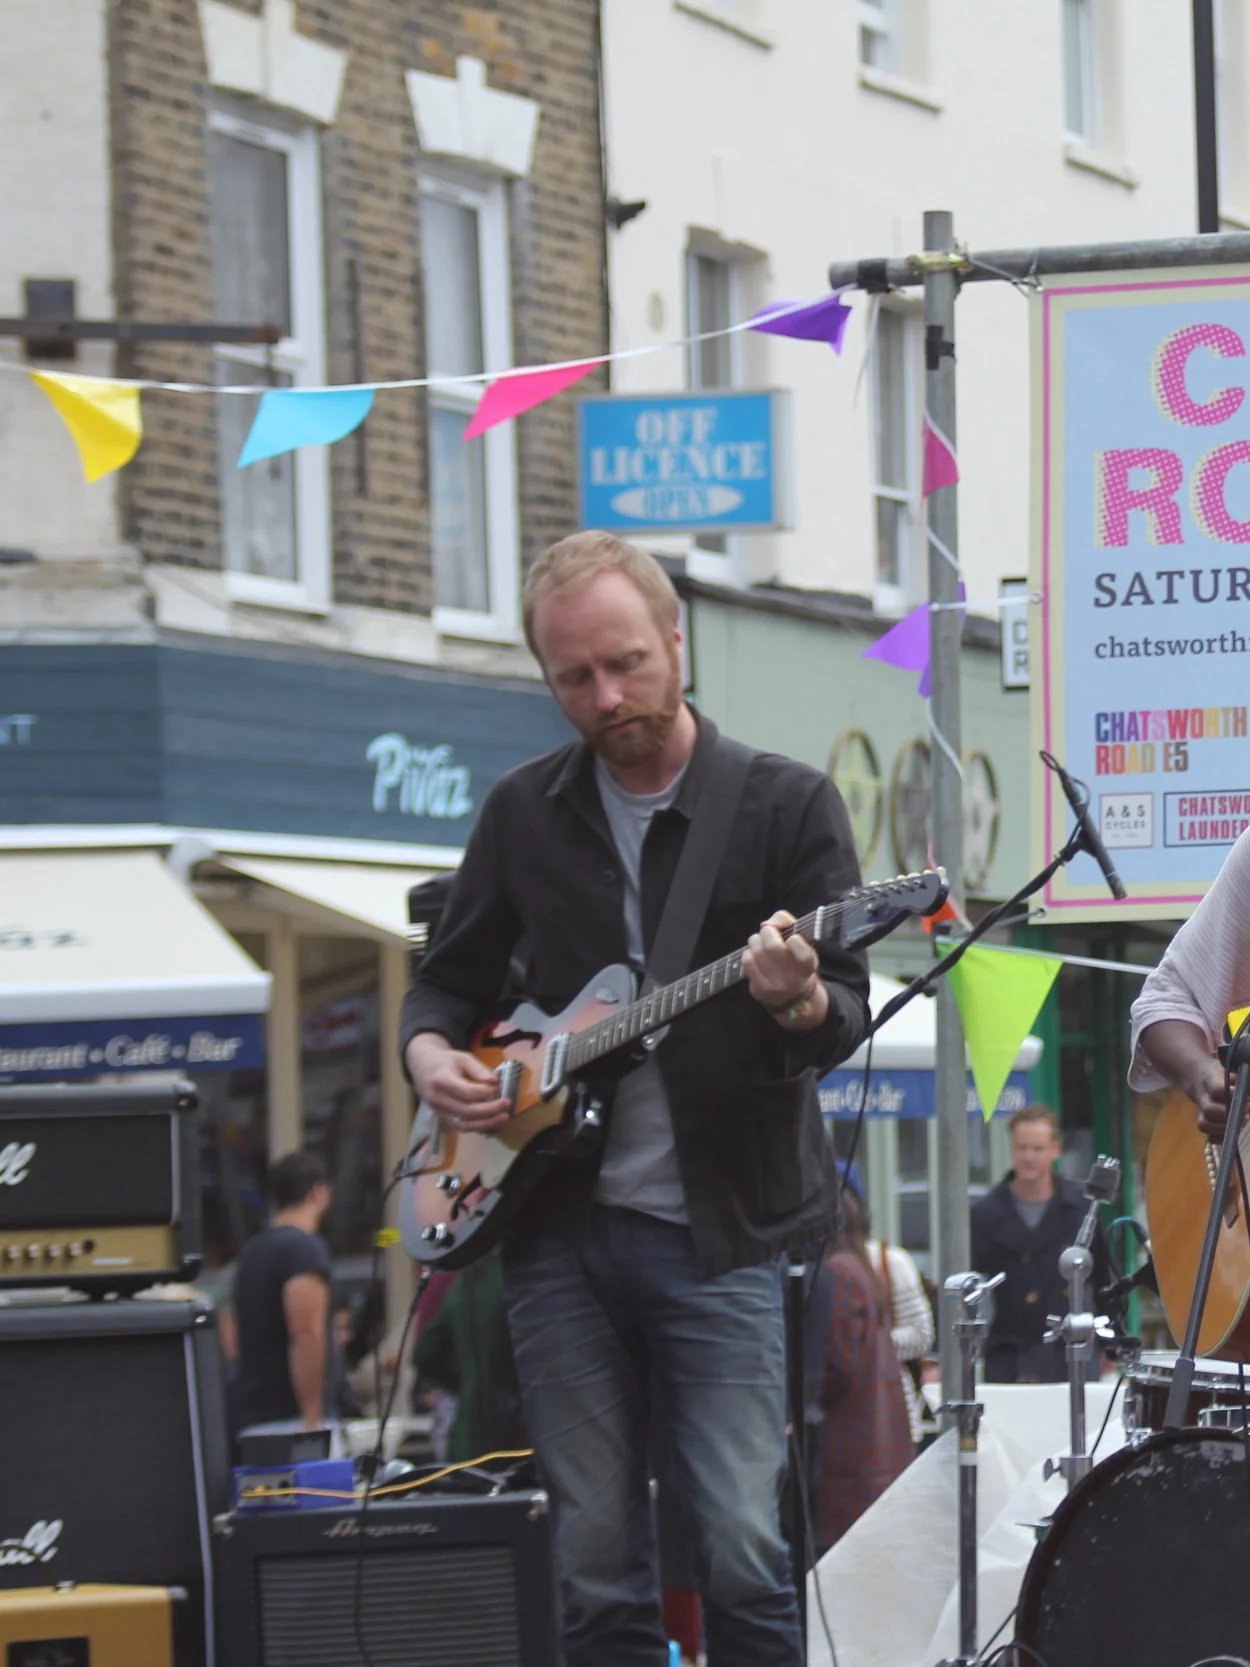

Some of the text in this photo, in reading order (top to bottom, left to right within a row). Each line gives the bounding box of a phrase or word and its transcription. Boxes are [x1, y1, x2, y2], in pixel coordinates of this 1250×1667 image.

[635, 406, 717, 447] OFF
[590, 440, 767, 486] LICENCE
[1095, 706, 1248, 743] CHATSWORTH
[1095, 741, 1189, 776] ROAD E5
[1105, 804, 1146, 818] A & S
[1105, 819, 1146, 830] CYCLES
[187, 1031, 243, 1063] Bar
